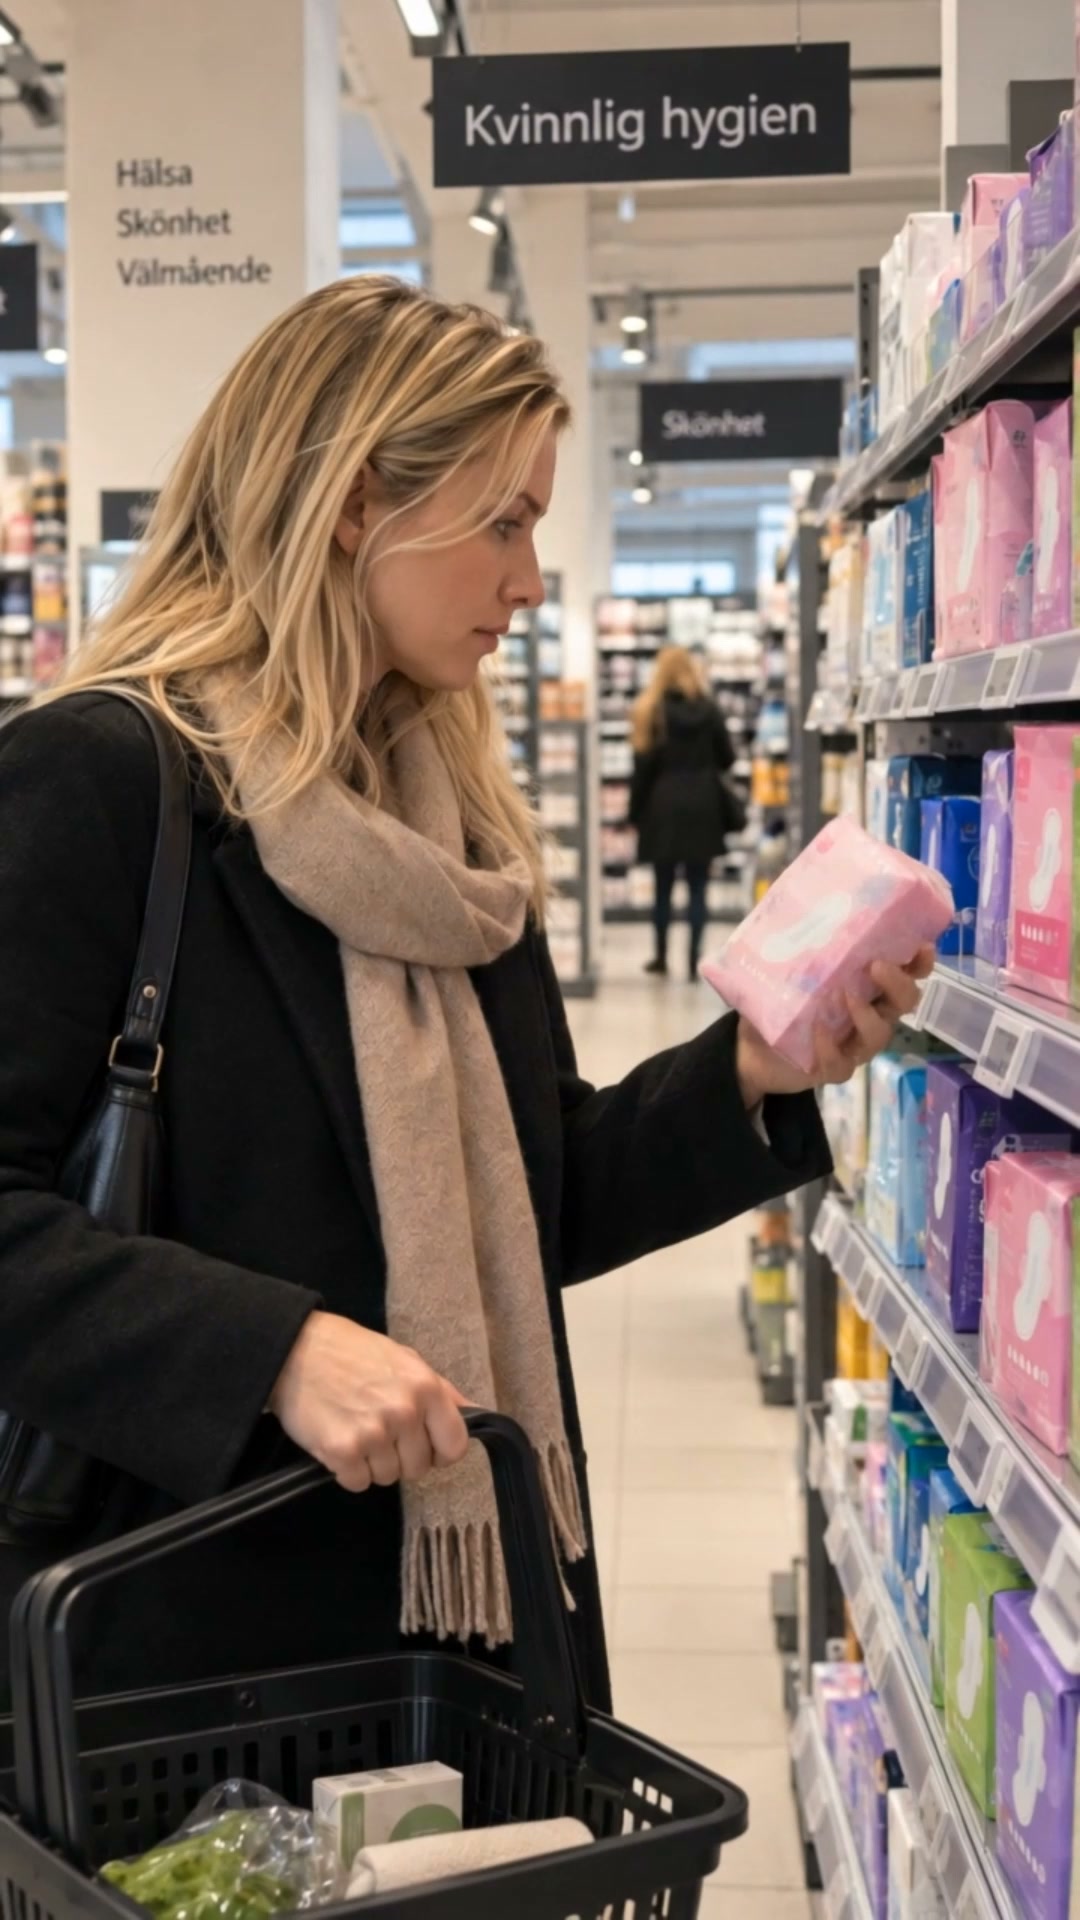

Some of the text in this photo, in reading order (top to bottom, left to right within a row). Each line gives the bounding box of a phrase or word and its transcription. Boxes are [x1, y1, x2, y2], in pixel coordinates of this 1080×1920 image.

[464, 93, 817, 152] Kvinnlig hygien
[116, 158, 193, 188] Hälsa
[116, 207, 232, 238] Skönhet
[116, 255, 272, 287] Välmående
[662, 409, 766, 439] Skönhet
